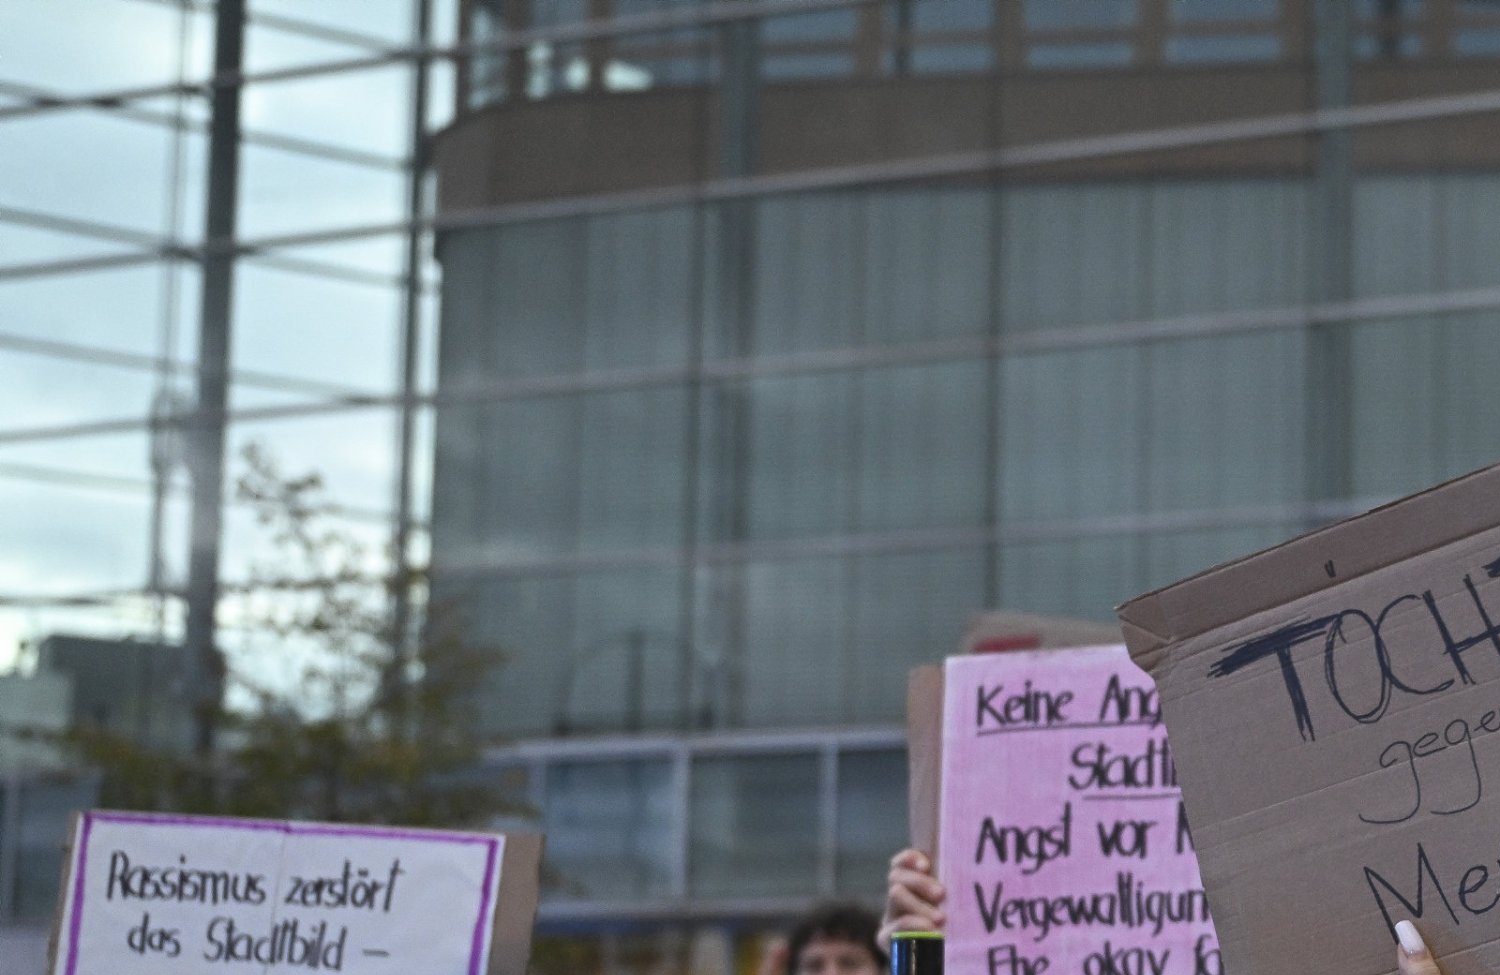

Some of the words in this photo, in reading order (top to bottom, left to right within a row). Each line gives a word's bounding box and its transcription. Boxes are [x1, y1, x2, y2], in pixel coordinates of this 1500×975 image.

[975, 680, 1074, 728] Keine
[1099, 673, 1162, 728] Ang
[974, 801, 1072, 875] Angst
[1097, 819, 1158, 859] vor
[106, 850, 267, 905] Rassismus
[283, 858, 403, 913] zerstört
[974, 872, 1210, 943] Vergewaltigun
[127, 913, 181, 958] das
[203, 915, 347, 972] Stadtbild
